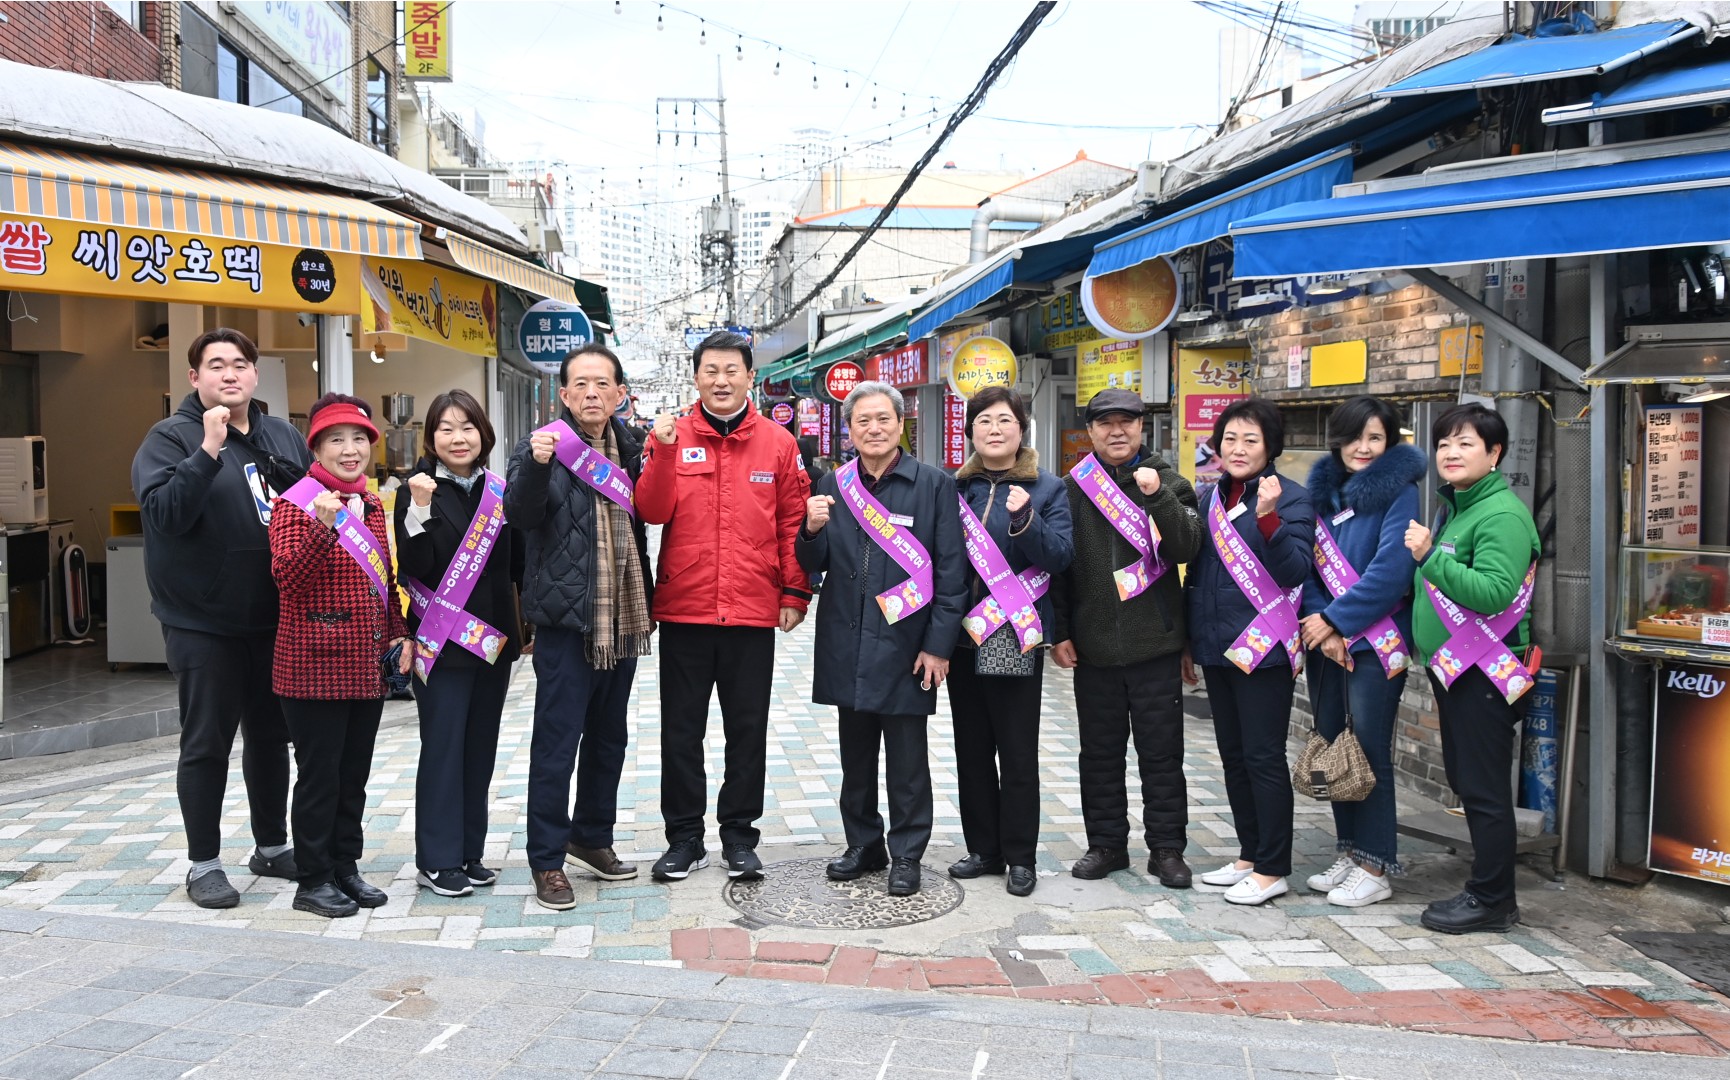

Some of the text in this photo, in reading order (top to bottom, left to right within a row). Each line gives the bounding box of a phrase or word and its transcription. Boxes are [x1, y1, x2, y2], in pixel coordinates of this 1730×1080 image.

[418, 63, 433, 73] 2F
[72, 229, 263, 293] 씨앗호떡
[301, 261, 327, 273] 앞으로
[310, 278, 332, 293] 30년
[448, 294, 483, 326] 아이스크림
[833, 368, 857, 379] 유명한
[957, 368, 1011, 389] 씨앗호떡
[1681, 412, 1699, 424] 1,000원
[1649, 432, 1660, 446] 튀김
[1649, 451, 1660, 465] 튀김
[1680, 450, 1699, 462] 1,000원
[1093, 470, 1145, 529] 시장에서 장보GO!
[848, 484, 865, 510] 행복한
[892, 534, 925, 569] 보내세요
[962, 514, 989, 550] 장보GO!
[1095, 492, 1151, 553] 전통시장 살리GO!
[1646, 527, 1663, 541] 떡볶이
[345, 525, 372, 554] 행복한
[442, 513, 489, 596] 전통시장 살리GO!
[465, 501, 504, 581] 시장에서 장보GO!
[1214, 504, 1260, 577] 시장에서 장보GO!
[1213, 529, 1264, 604] 전통시장 살리GO!
[1322, 539, 1347, 577] 장보GO!
[1322, 564, 1347, 597] 살리GO
[1434, 590, 1467, 626] 보내세요
[1707, 617, 1729, 627] 닭강정
[1666, 671, 1726, 698] Kelly
